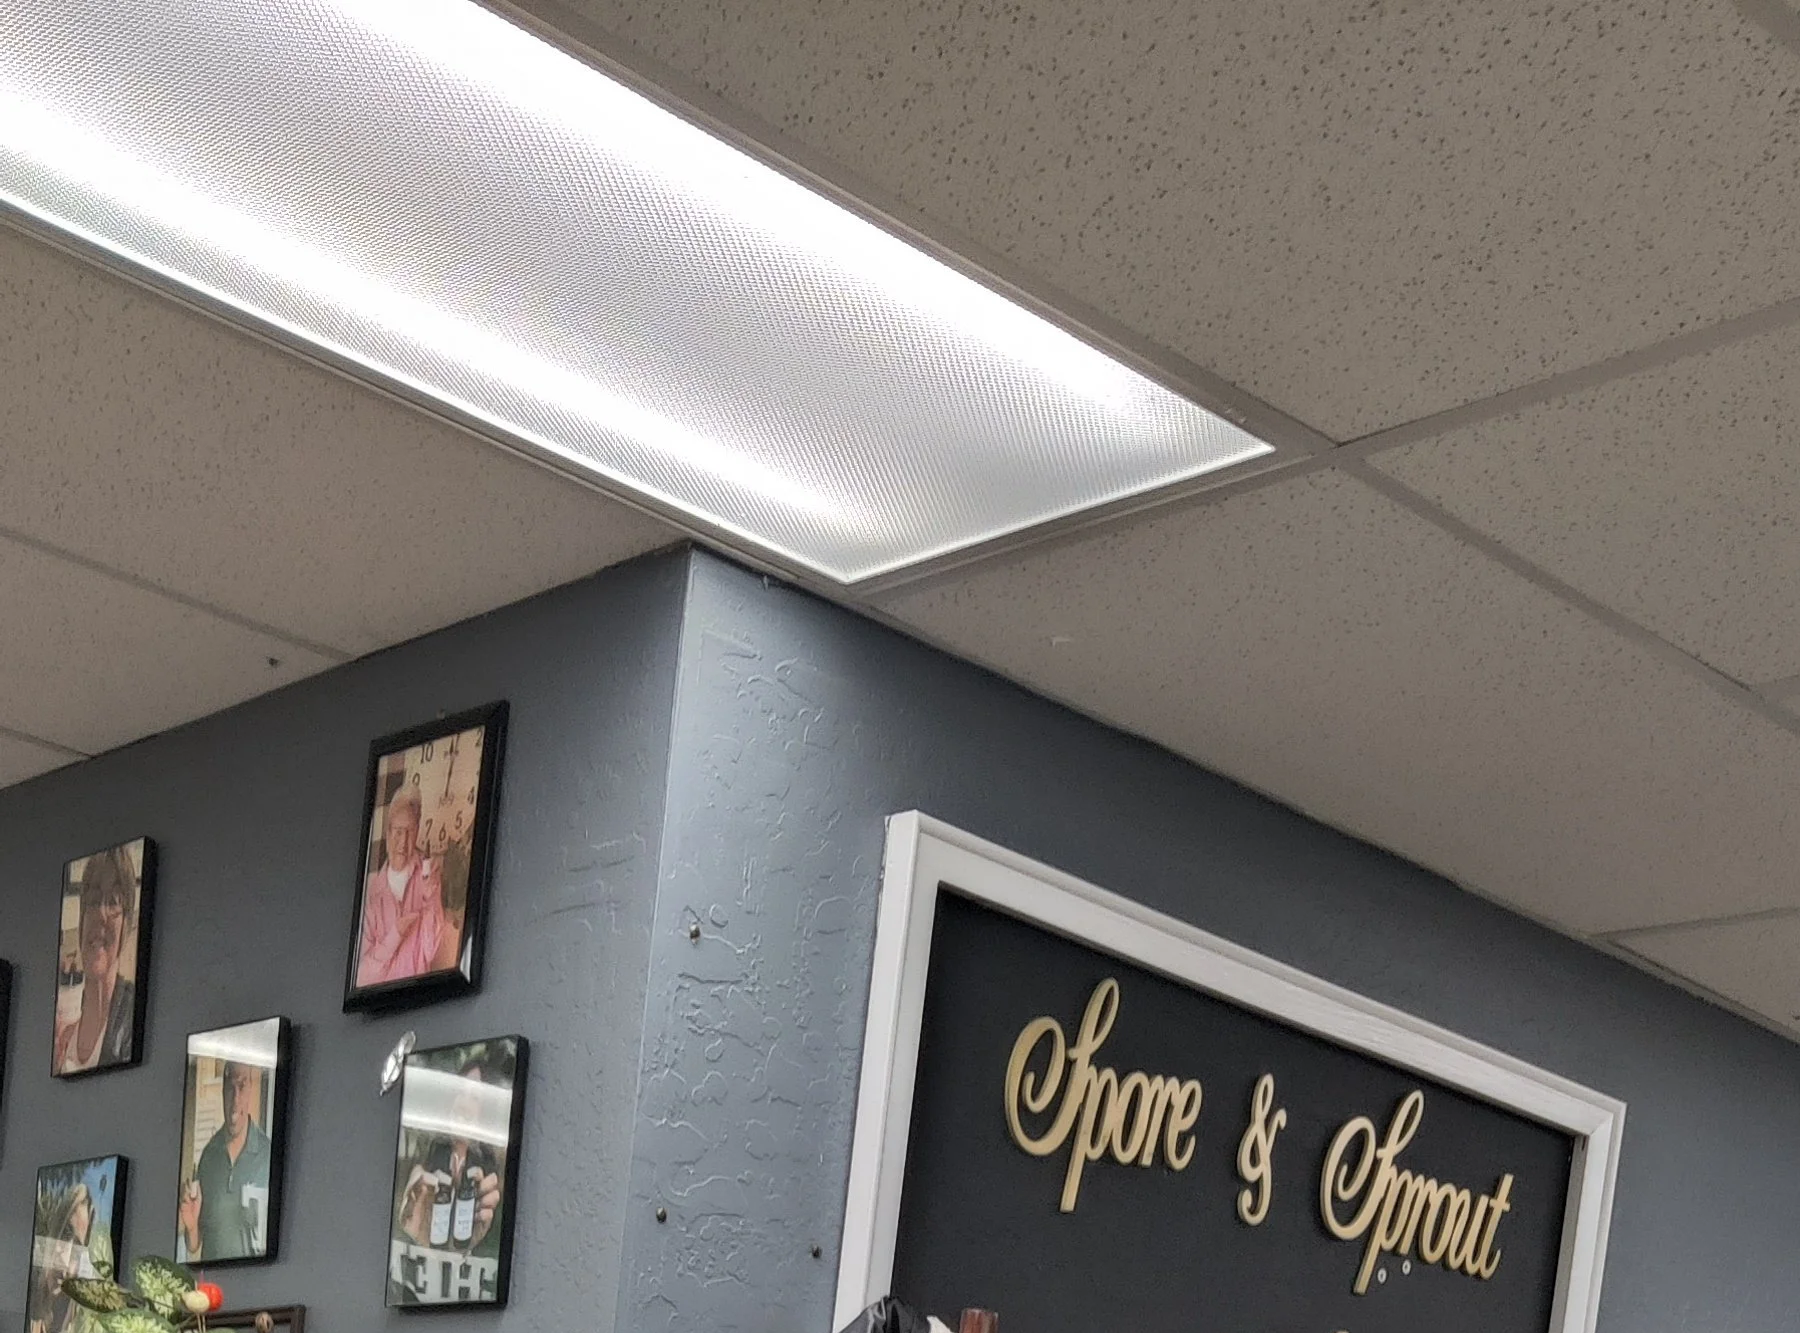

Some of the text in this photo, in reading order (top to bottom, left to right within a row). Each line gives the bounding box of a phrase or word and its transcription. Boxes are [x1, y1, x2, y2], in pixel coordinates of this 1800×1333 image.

[1006, 977, 1511, 1295] Spore & Sprout
